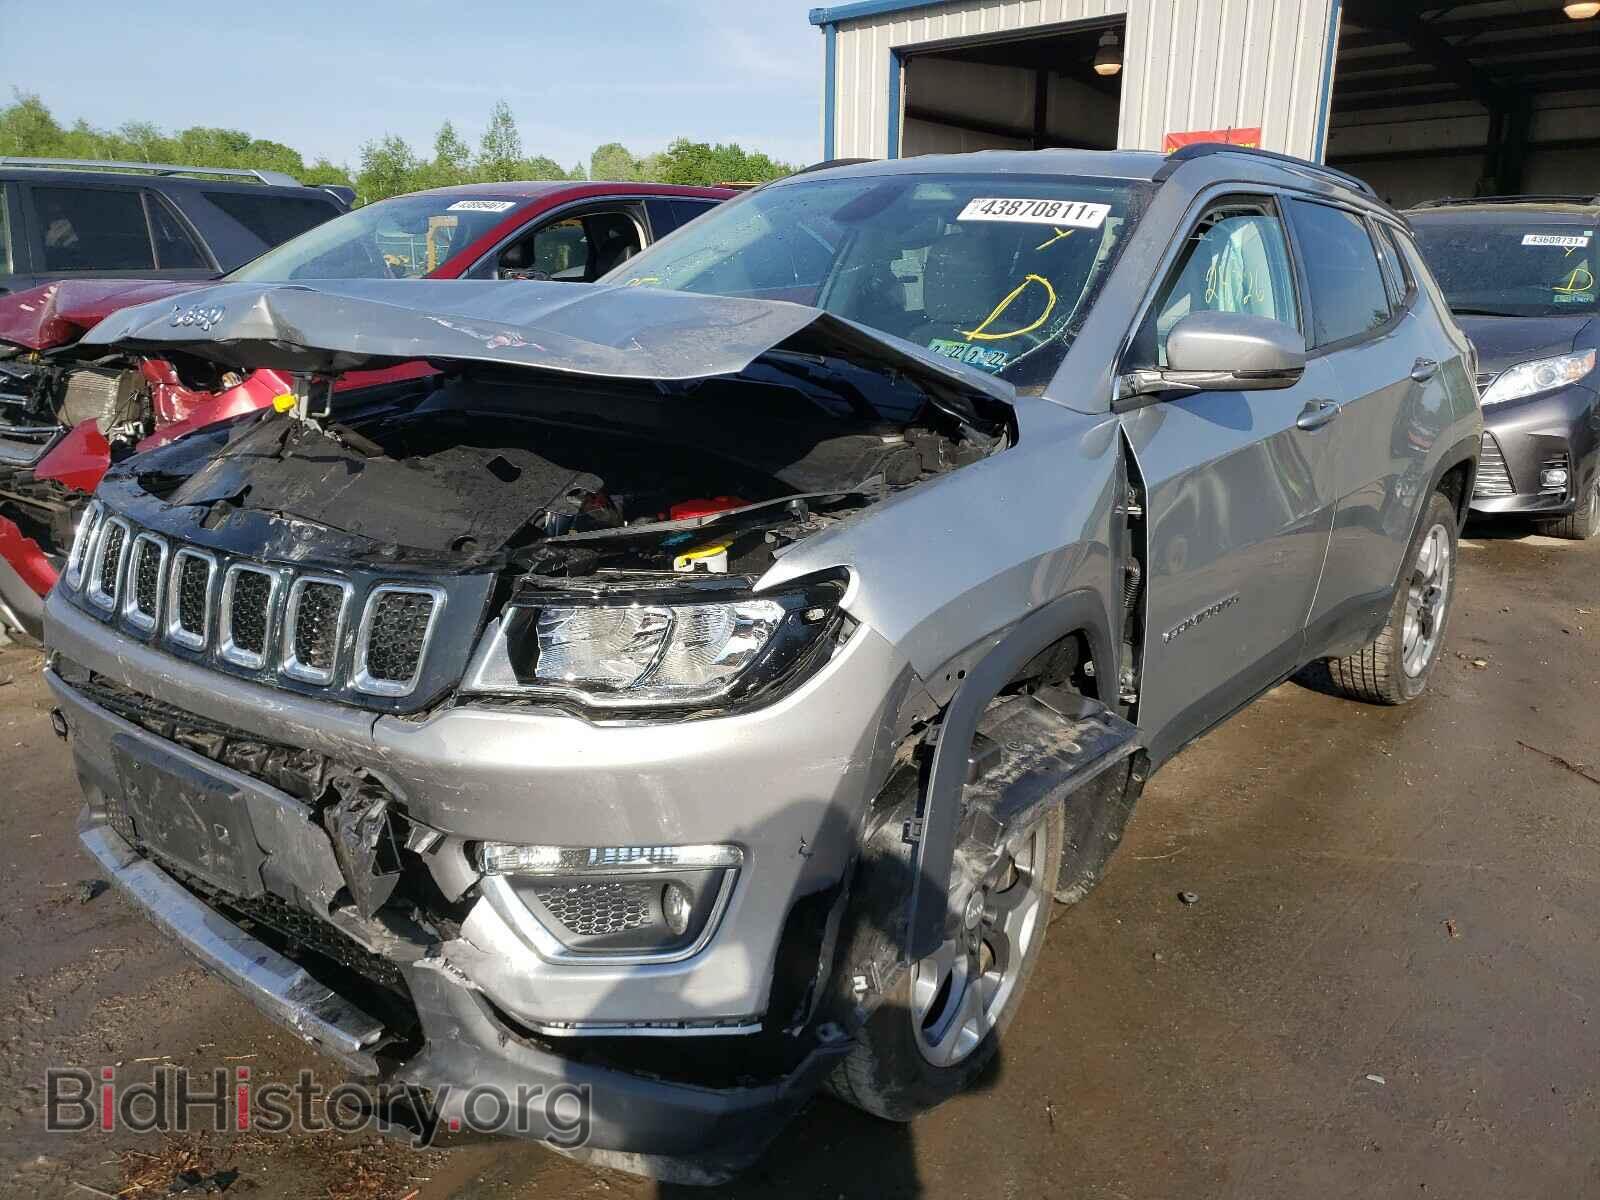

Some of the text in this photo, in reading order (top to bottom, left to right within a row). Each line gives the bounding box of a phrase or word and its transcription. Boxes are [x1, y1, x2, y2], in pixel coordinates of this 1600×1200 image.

[980, 201, 1089, 220] 43870811
[1087, 210, 1098, 219] F
[955, 274, 1056, 341] D
[968, 350, 979, 362] 2
